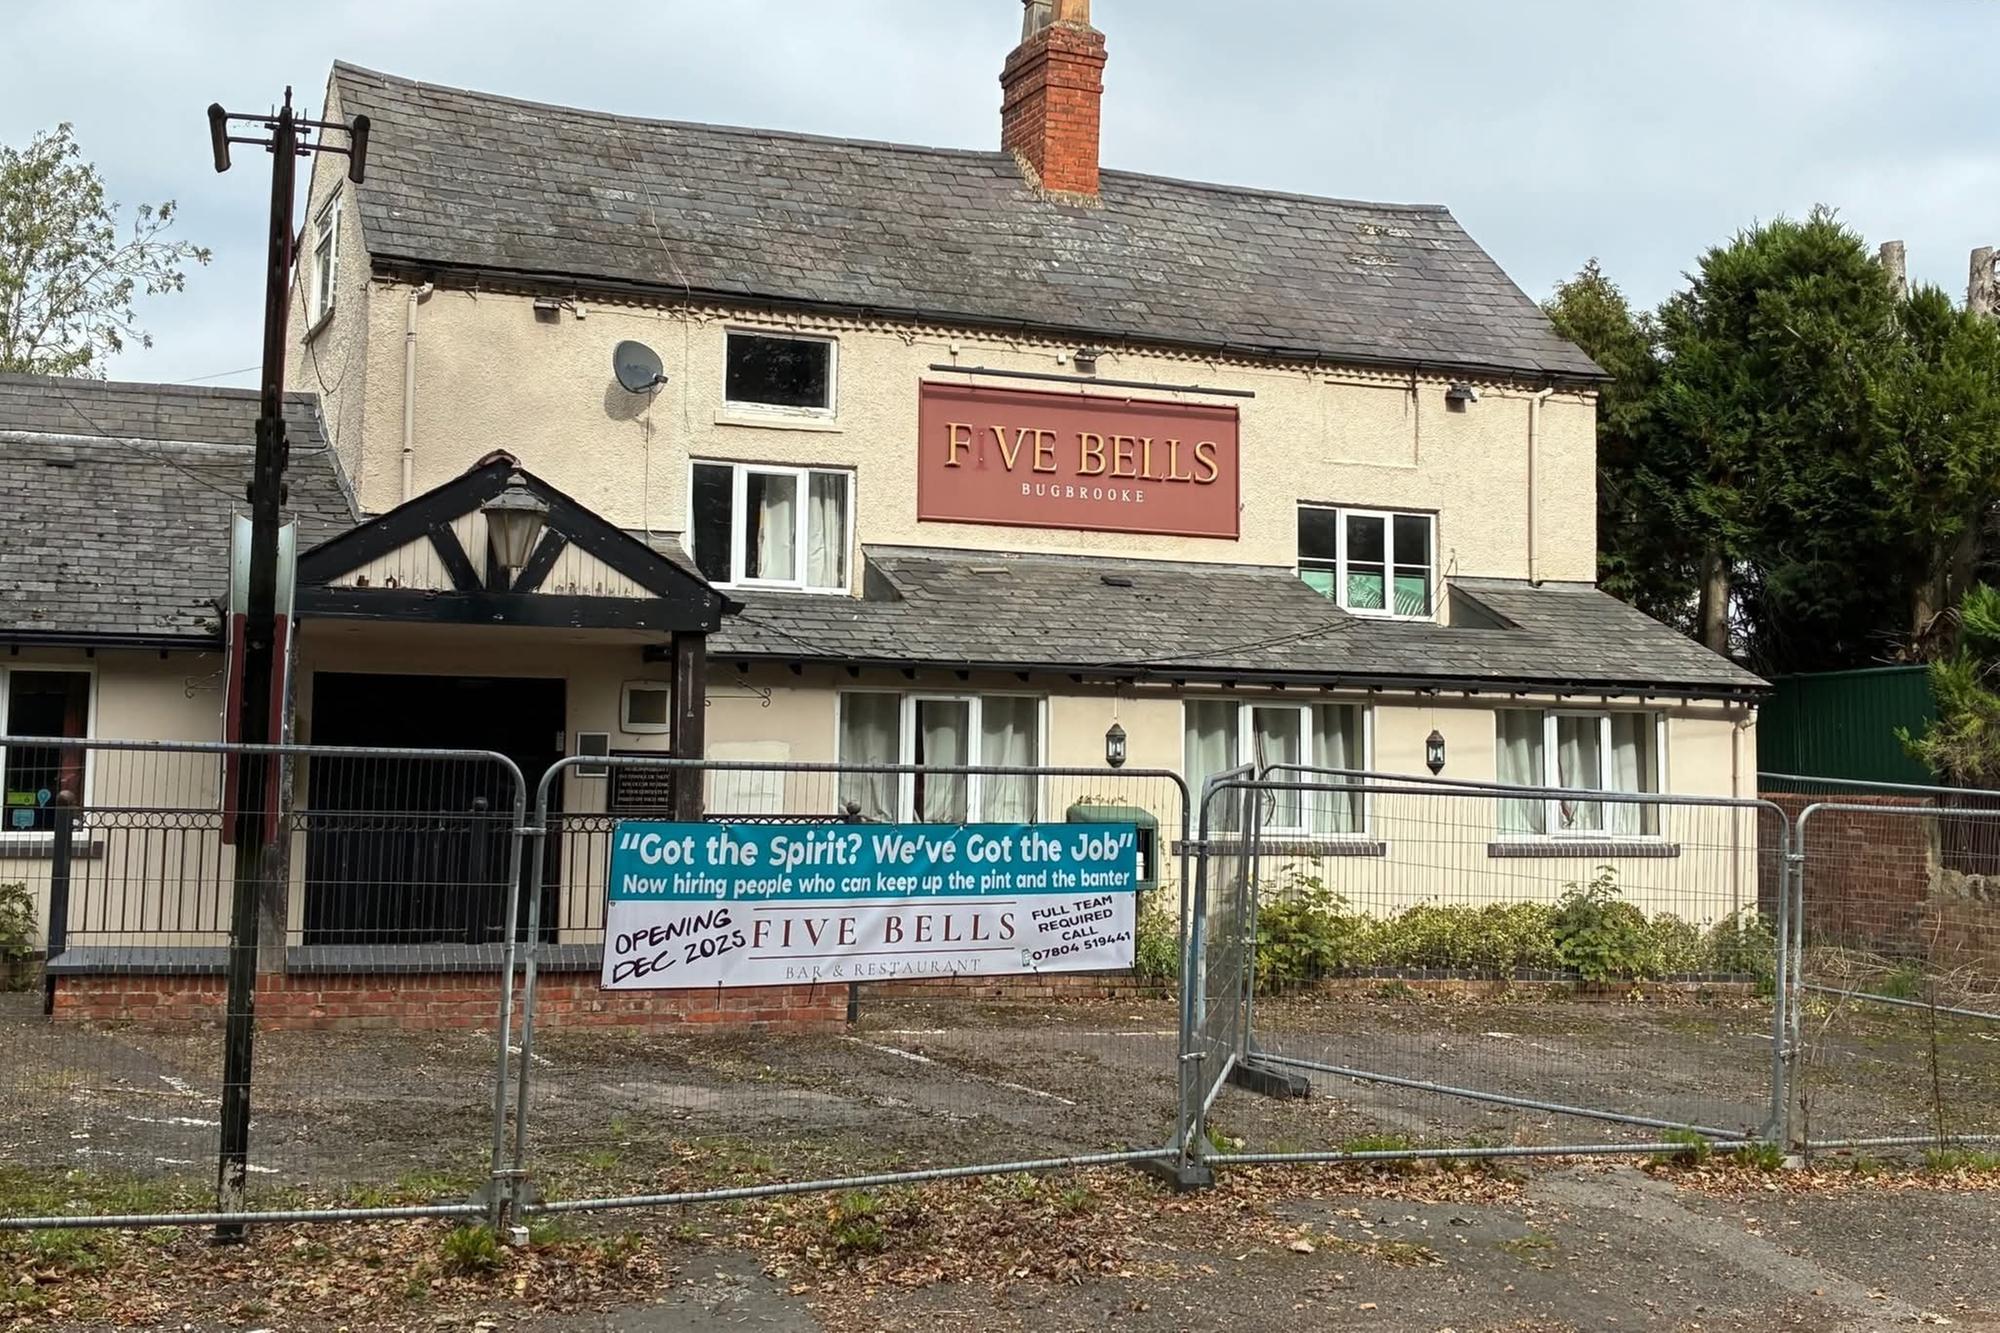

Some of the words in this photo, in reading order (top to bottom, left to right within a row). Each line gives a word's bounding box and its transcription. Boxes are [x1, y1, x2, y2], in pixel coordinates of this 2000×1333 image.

[1075, 431, 1219, 484] BELLS
[1022, 483, 1144, 503] BUGBROOKE
[706, 832, 758, 866] the
[769, 830, 863, 873] Spirit?
[872, 834, 956, 864] We've
[966, 833, 1012, 863] Got
[1020, 831, 1062, 862] the
[622, 874, 668, 894] Now
[673, 872, 726, 899] hiring
[734, 872, 791, 898] people
[799, 873, 835, 893] who
[841, 876, 871, 892] can
[877, 872, 917, 894] keep
[922, 875, 943, 894] up
[948, 870, 975, 890] the
[980, 869, 1012, 894] pint
[1016, 869, 1047, 889] and
[1052, 869, 1076, 888] the
[1080, 868, 1129, 887] banter
[1031, 905, 1070, 921] FULL
[1073, 895, 1113, 912] TEAM
[1038, 908, 1113, 933] REQUIRED
[615, 908, 733, 955] OPENING
[752, 917, 857, 949] FIVE
[883, 912, 1016, 944] BELLS
[1061, 926, 1099, 942] CALL
[612, 950, 677, 984] DEC
[684, 929, 746, 964] 2025
[1032, 943, 1080, 962] 07804
[1084, 931, 1132, 950] 519441
[785, 965, 823, 980] BAR
[833, 964, 844, 977] &
[854, 958, 981, 977] RESTAURANT
